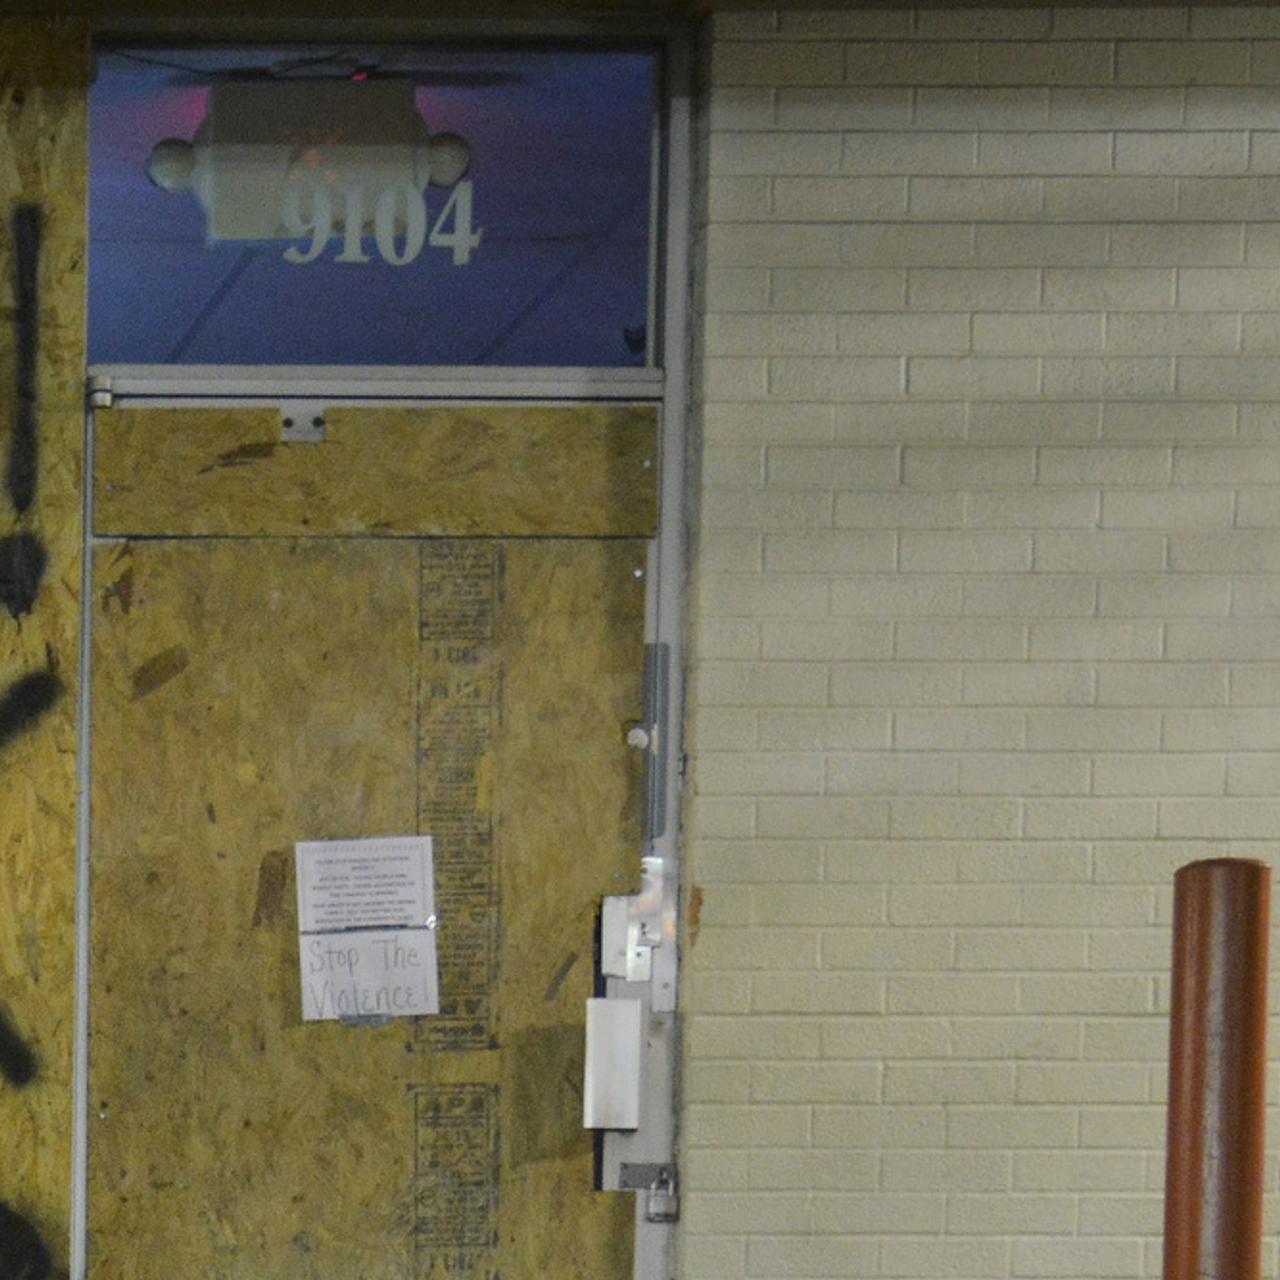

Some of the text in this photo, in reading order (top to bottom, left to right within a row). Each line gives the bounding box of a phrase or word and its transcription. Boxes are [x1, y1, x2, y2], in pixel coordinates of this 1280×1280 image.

[282, 179, 482, 266] 9104
[309, 935, 421, 976] Stop The
